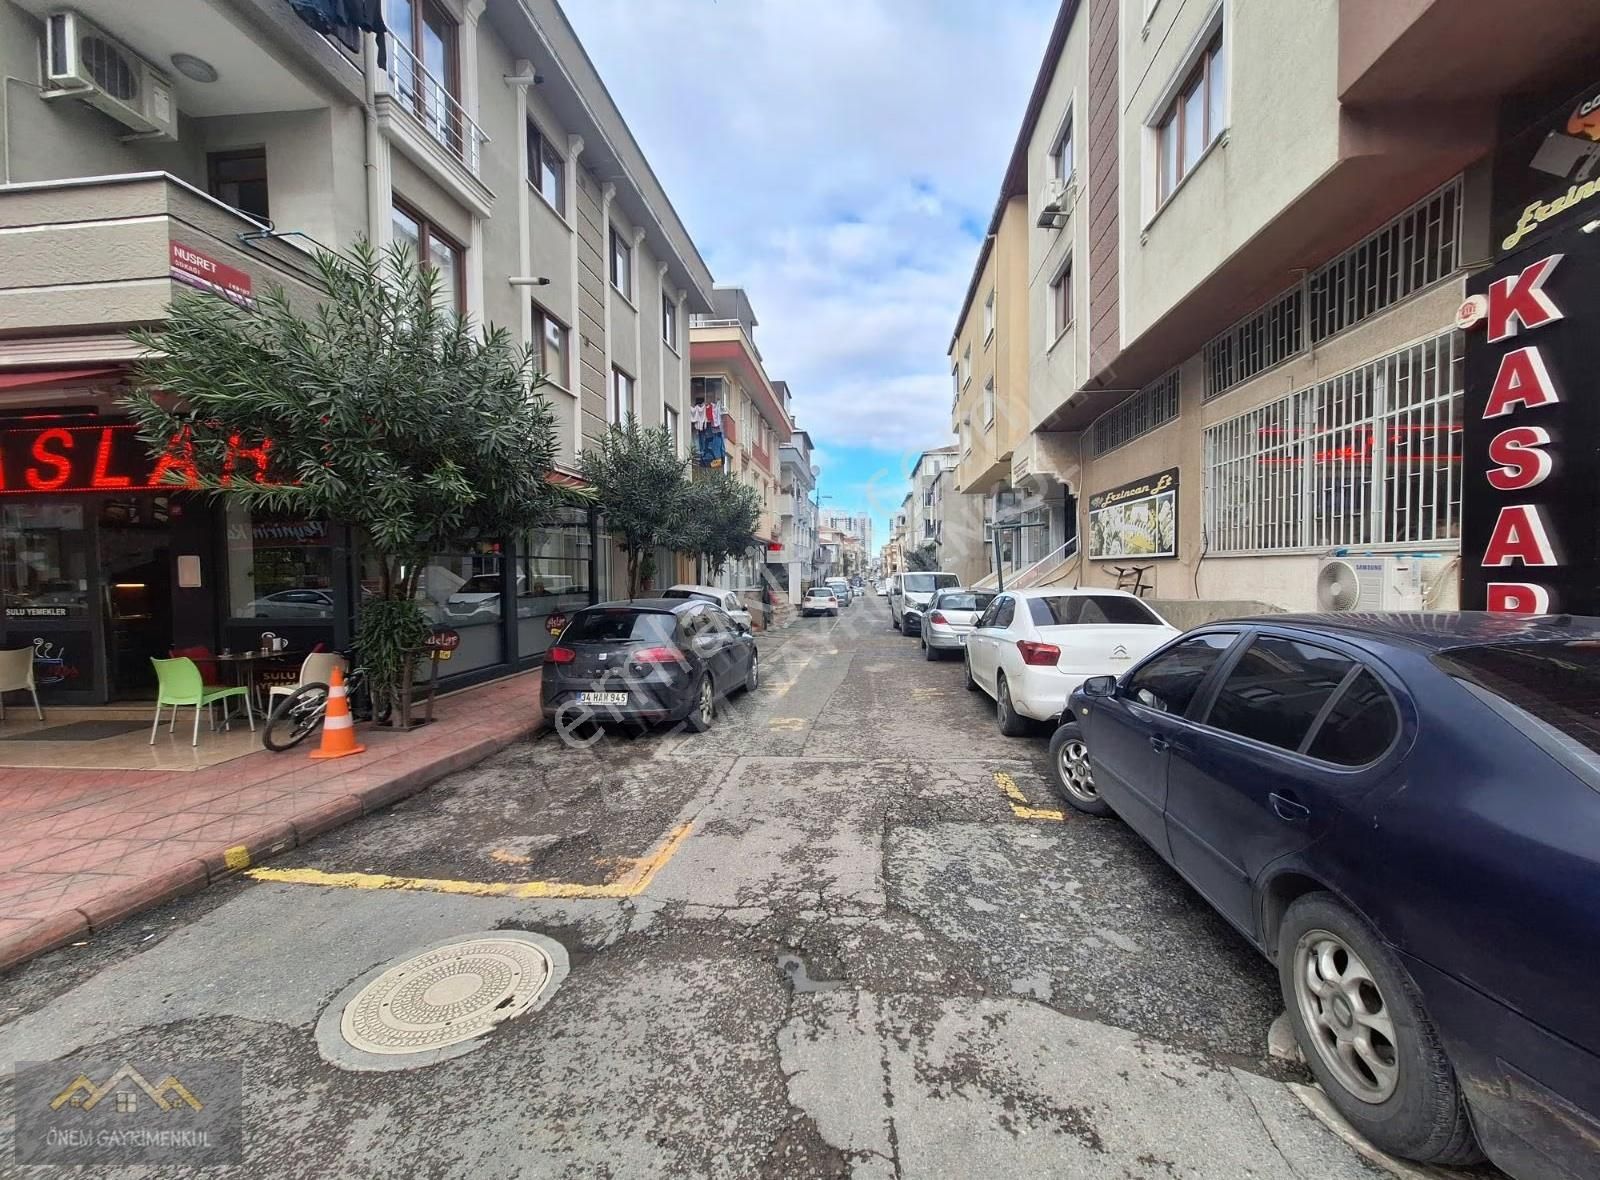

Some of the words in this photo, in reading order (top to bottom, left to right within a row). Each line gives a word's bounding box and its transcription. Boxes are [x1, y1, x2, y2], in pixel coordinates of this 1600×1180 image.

[174, 246, 217, 273] NUSRET
[1101, 485, 1150, 508] Erzincan
[6, 608, 25, 616] SULU
[27, 608, 66, 616] YEMEKLER
[263, 671, 296, 680] SULU
[581, 693, 590, 702] 34
[610, 693, 626, 702] 945
